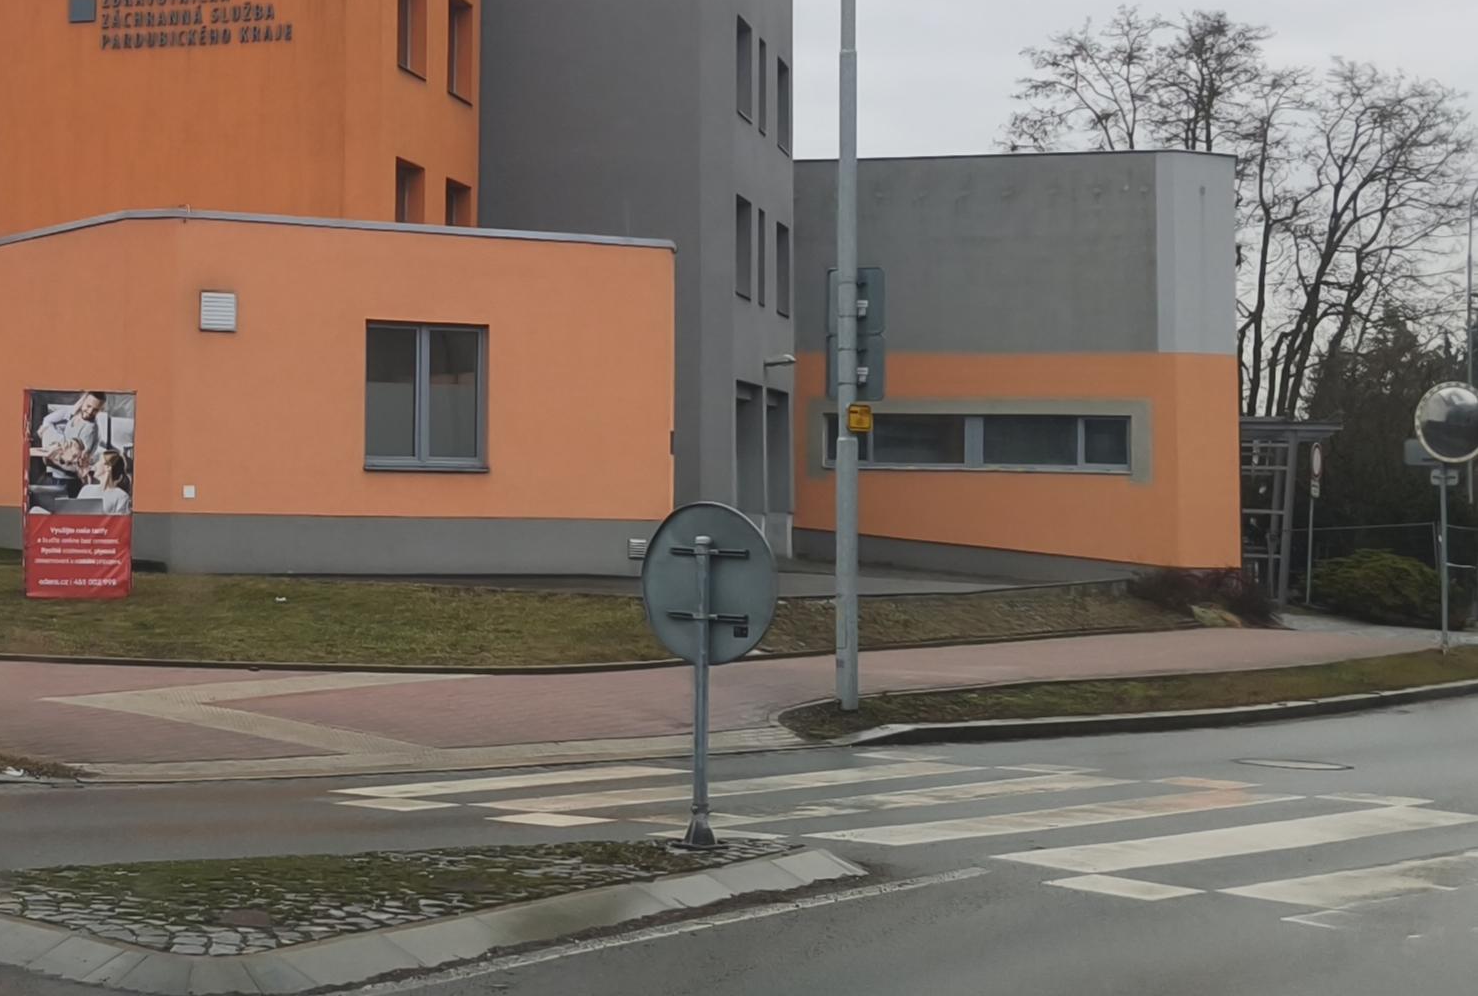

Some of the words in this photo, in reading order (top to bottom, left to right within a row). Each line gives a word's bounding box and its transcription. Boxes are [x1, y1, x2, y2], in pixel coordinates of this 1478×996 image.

[101, 5, 203, 30] ZÁCHRANNÁ
[210, 2, 276, 24] SLUŽBA
[101, 25, 231, 50] PARDUBICKÉHO
[240, 24, 293, 44] KRAJE
